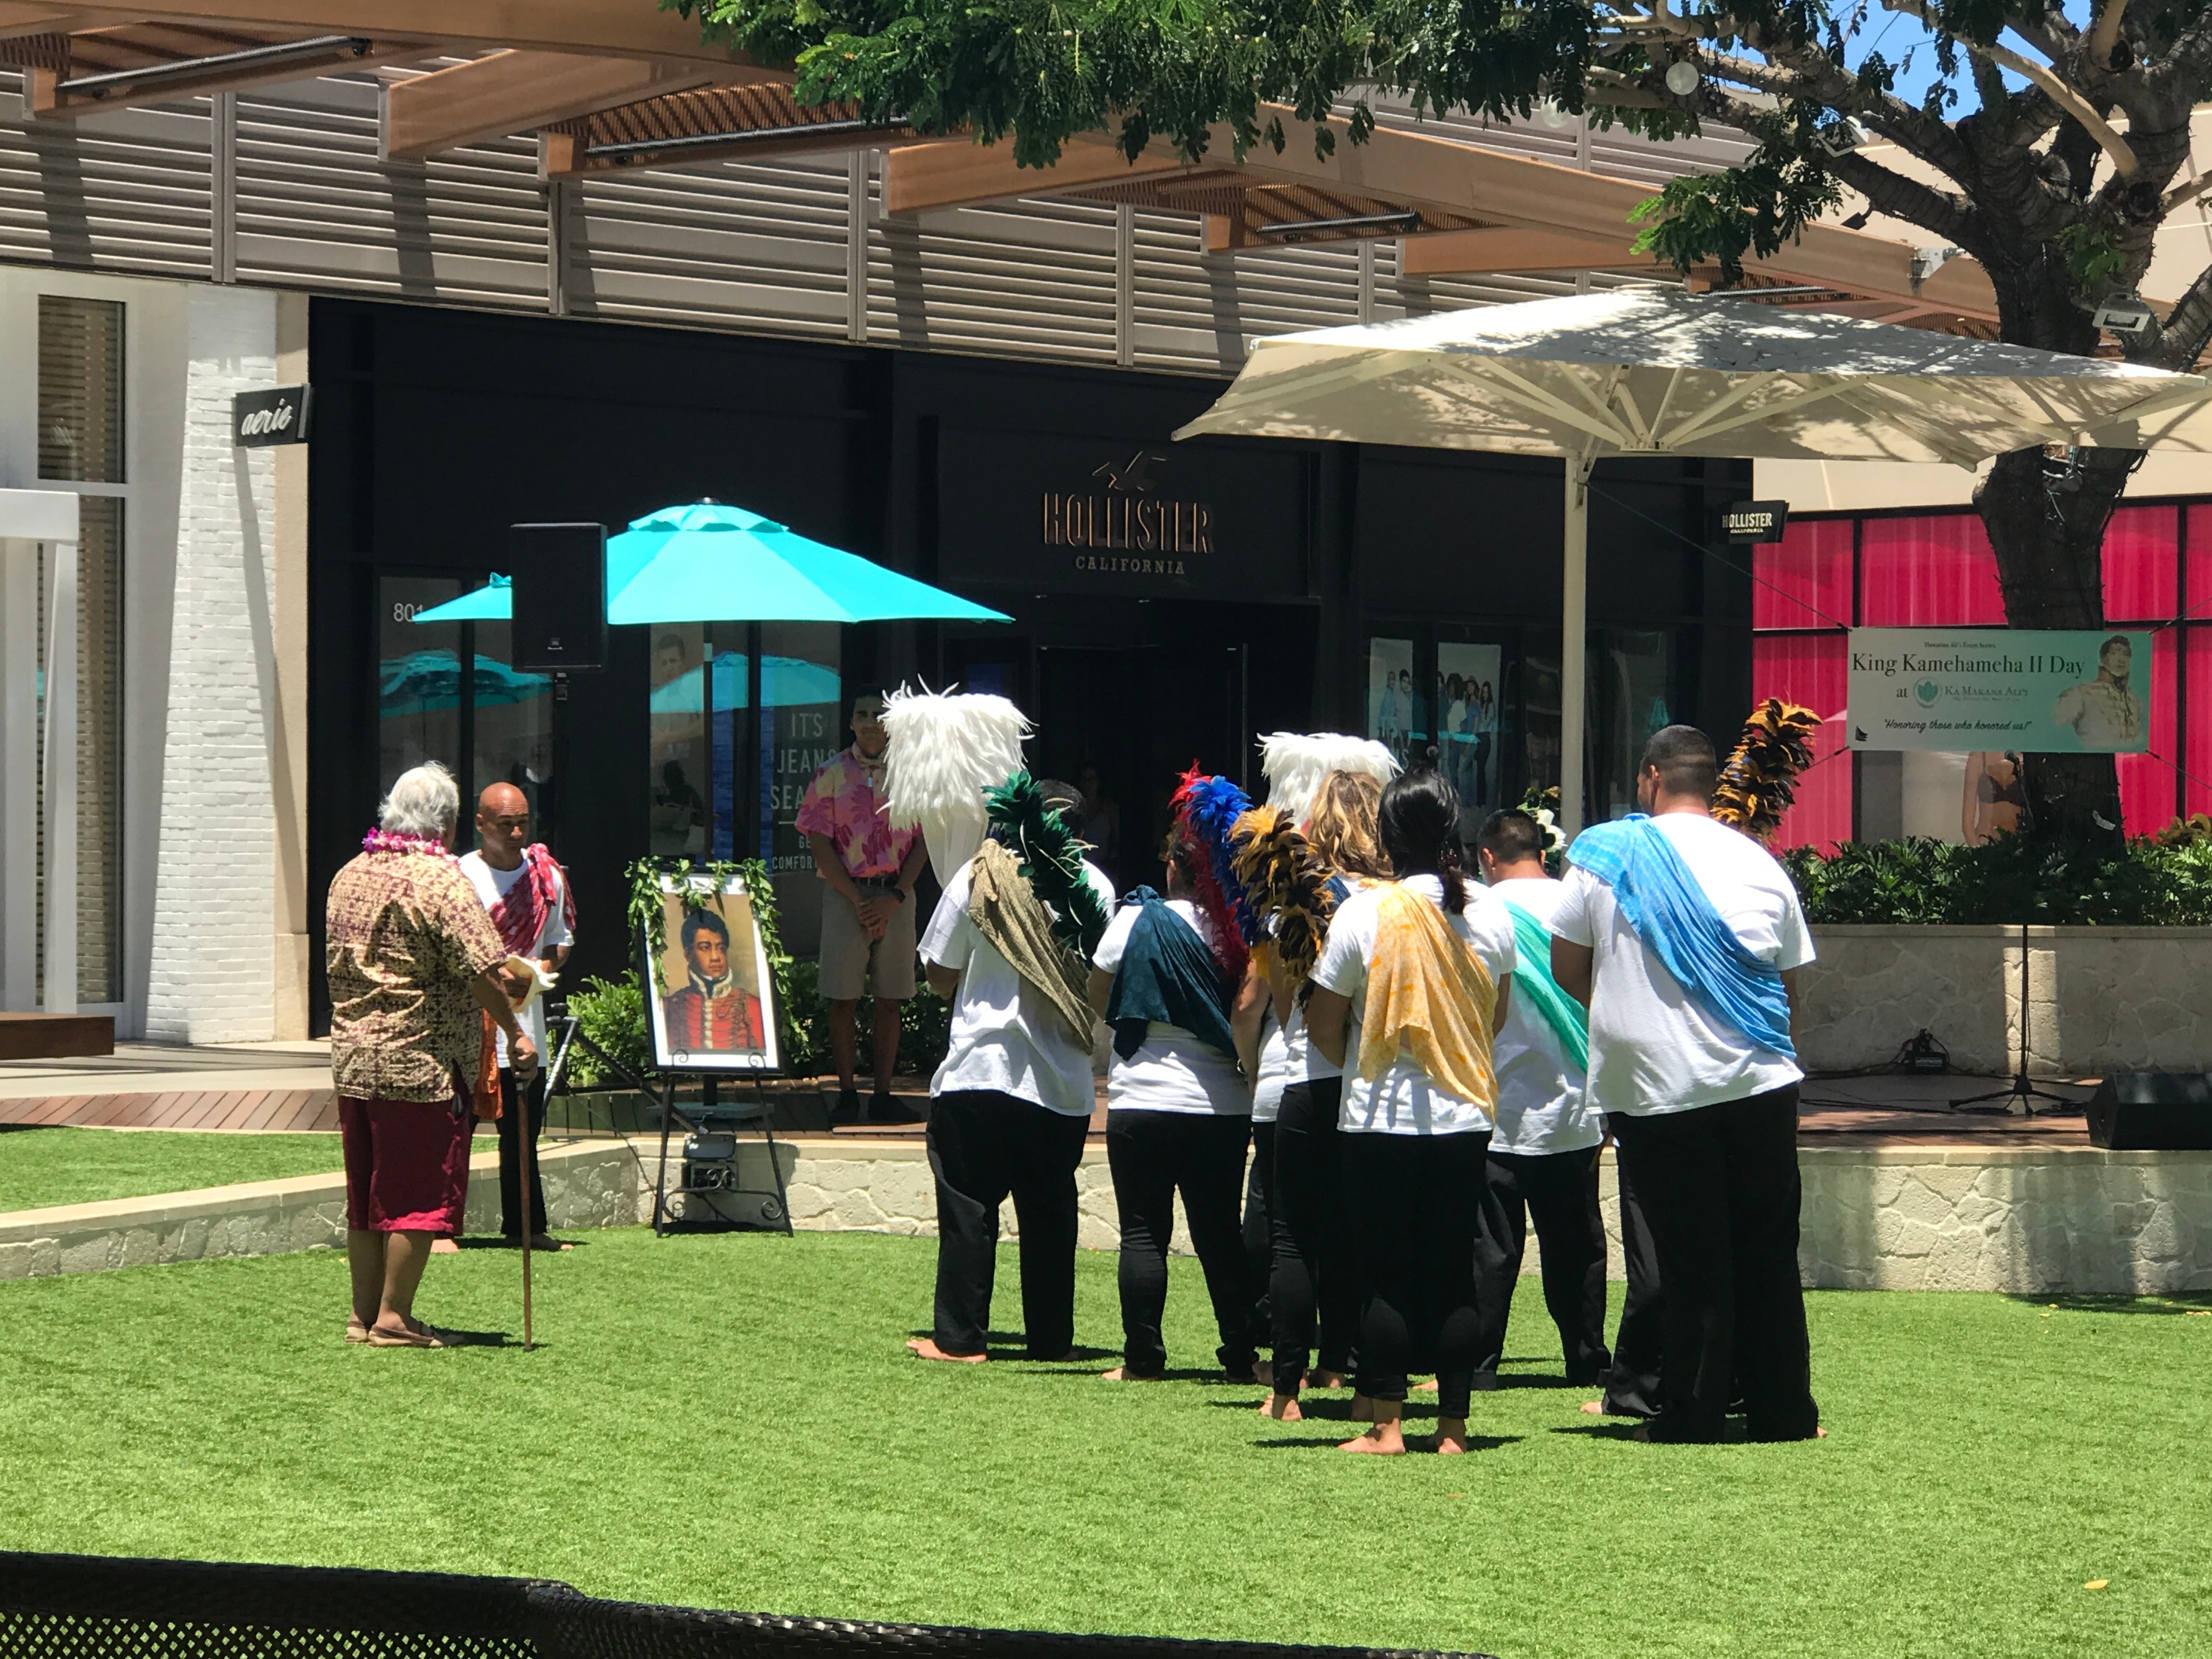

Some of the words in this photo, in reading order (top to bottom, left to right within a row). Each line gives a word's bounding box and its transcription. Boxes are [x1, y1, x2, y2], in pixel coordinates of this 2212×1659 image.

[241, 398, 293, 435] aerie
[1042, 492, 1214, 554] HOLLISTER
[1722, 512, 1772, 528] HOLLISTER
[1075, 555, 1185, 574] CALIFORNIA
[1852, 653, 1897, 677] King
[1902, 653, 2023, 673] Kamehameha
[2029, 656, 2043, 673] II
[2050, 655, 2085, 679] Day
[1896, 687, 1908, 698] at
[1929, 719, 1952, 729] those
[1954, 720, 1972, 730] who
[1974, 719, 2012, 730] honored
